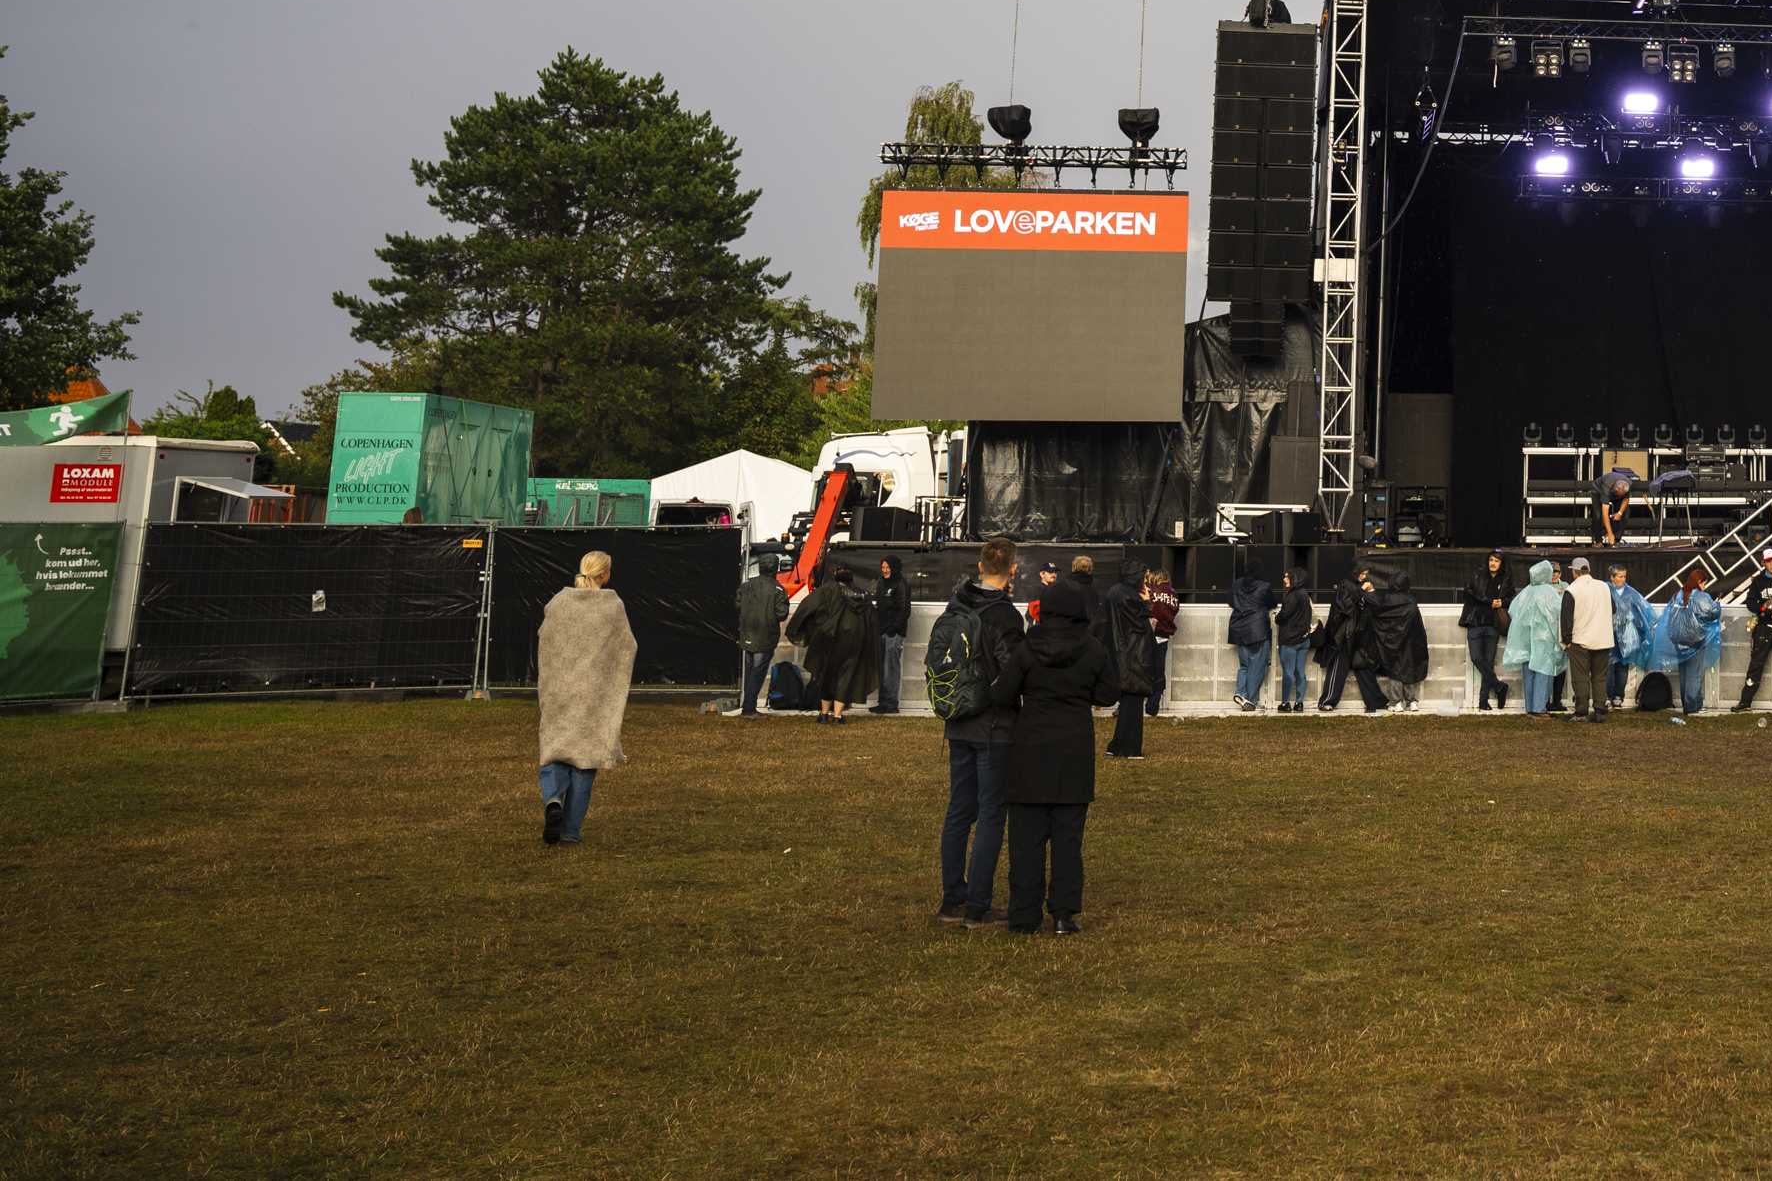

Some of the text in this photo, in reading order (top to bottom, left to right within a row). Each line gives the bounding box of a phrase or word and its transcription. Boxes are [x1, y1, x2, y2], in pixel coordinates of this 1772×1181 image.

[899, 211, 940, 228] KØGE
[341, 439, 414, 448] COPENHAGEN
[344, 448, 404, 484] LIGHT
[63, 468, 114, 478] LOXAM
[335, 483, 410, 493] PRODUCTION
[336, 496, 407, 504] WWW.CLP.DK
[45, 559, 67, 568] kom
[68, 559, 82, 567] ud
[35, 571, 58, 579] hvis
